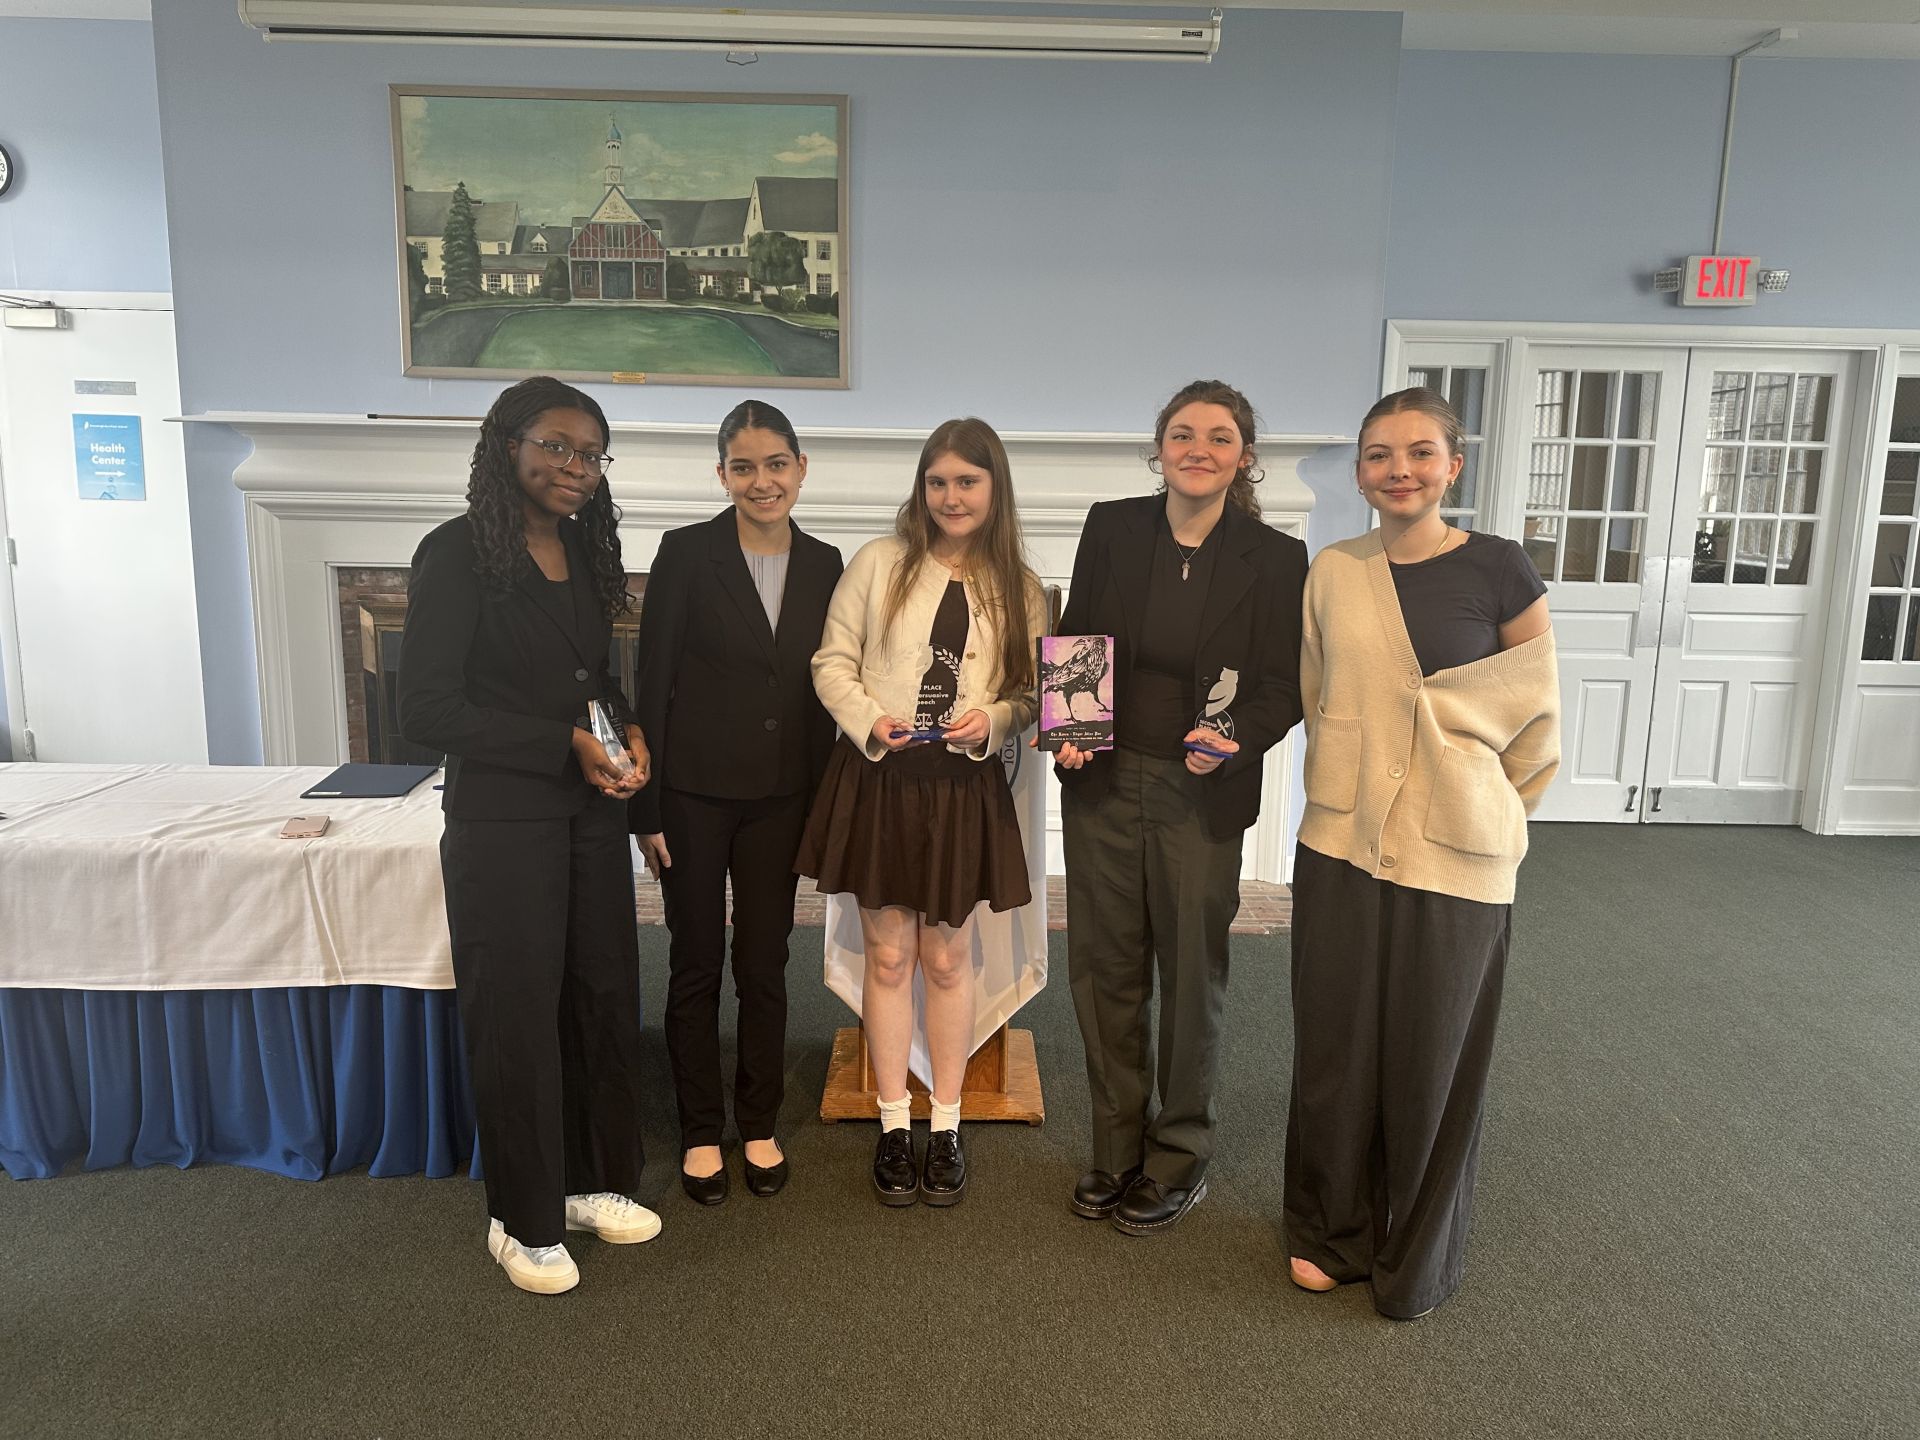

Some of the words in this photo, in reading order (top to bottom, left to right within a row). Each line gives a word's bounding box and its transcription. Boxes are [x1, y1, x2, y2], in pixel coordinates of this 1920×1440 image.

[1697, 258, 1752, 298] EXIT
[90, 443, 126, 453] Health
[91, 455, 126, 465] Center
